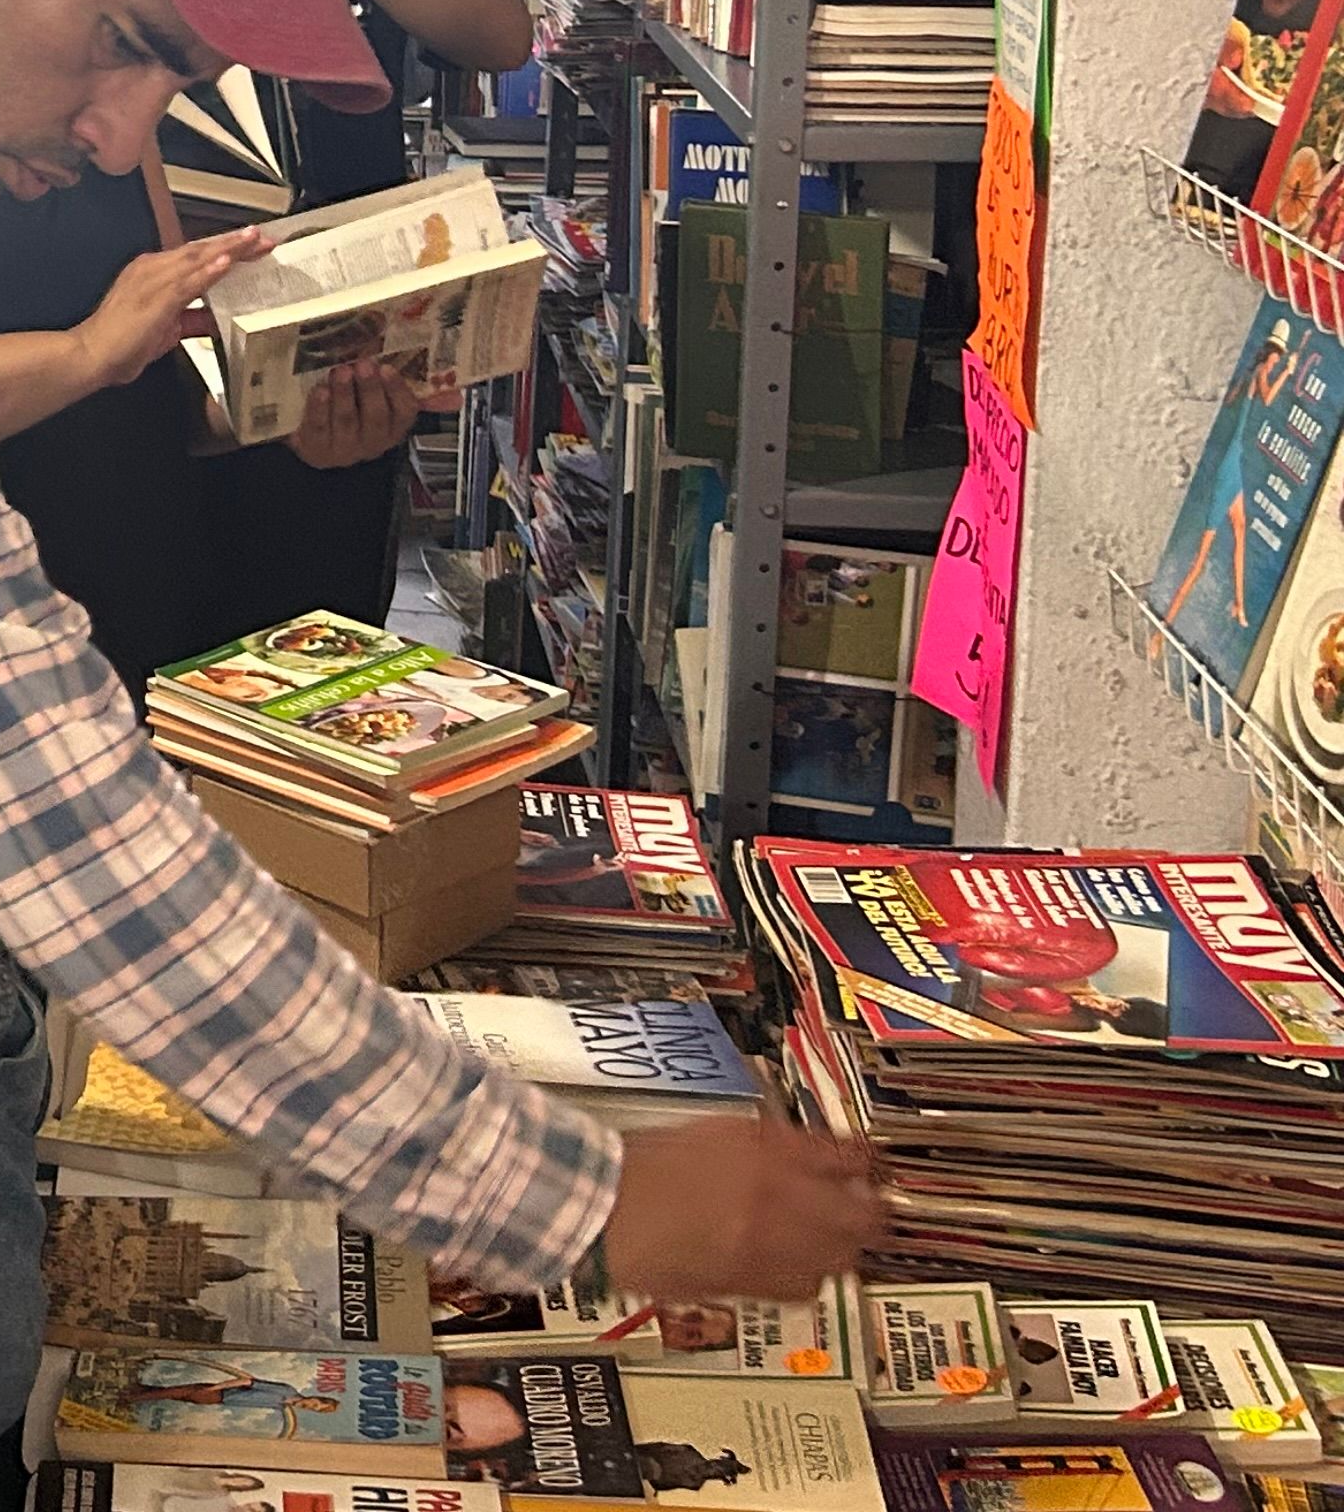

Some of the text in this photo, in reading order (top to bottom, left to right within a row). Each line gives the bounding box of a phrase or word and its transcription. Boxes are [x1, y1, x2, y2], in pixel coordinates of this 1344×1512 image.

[608, 793, 640, 855] INTERESANTE
[625, 794, 705, 875] muy
[857, 899, 890, 925] DEL
[874, 925, 934, 978] FUTURO!
[882, 900, 921, 933] ESTA
[906, 933, 950, 966] AQUI
[932, 967, 962, 985] LA
[1158, 862, 1234, 957] INTERESANTE
[1179, 860, 1318, 980] muy
[567, 998, 662, 1079] MAYO
[631, 998, 727, 1081] CLÍNICA
[288, 1288, 319, 1332] 1767
[339, 1279, 370, 1338] FROST
[375, 1251, 409, 1304] Pablo
[315, 1357, 347, 1394] PARIS
[889, 1331, 915, 1392] AFECTIVIDAD
[907, 1310, 936, 1382] LOS MISTERIOS
[1057, 1320, 1099, 1398] FAMILIA HOY
[1087, 1338, 1120, 1378] HACER
[1183, 1343, 1235, 1410] DECISIONES
[357, 1358, 400, 1440] ROUTARD
[519, 1365, 584, 1488] CUADRO MORENO
[571, 1363, 612, 1427] OSVALDO
[796, 1411, 834, 1482] CHIAPAS
